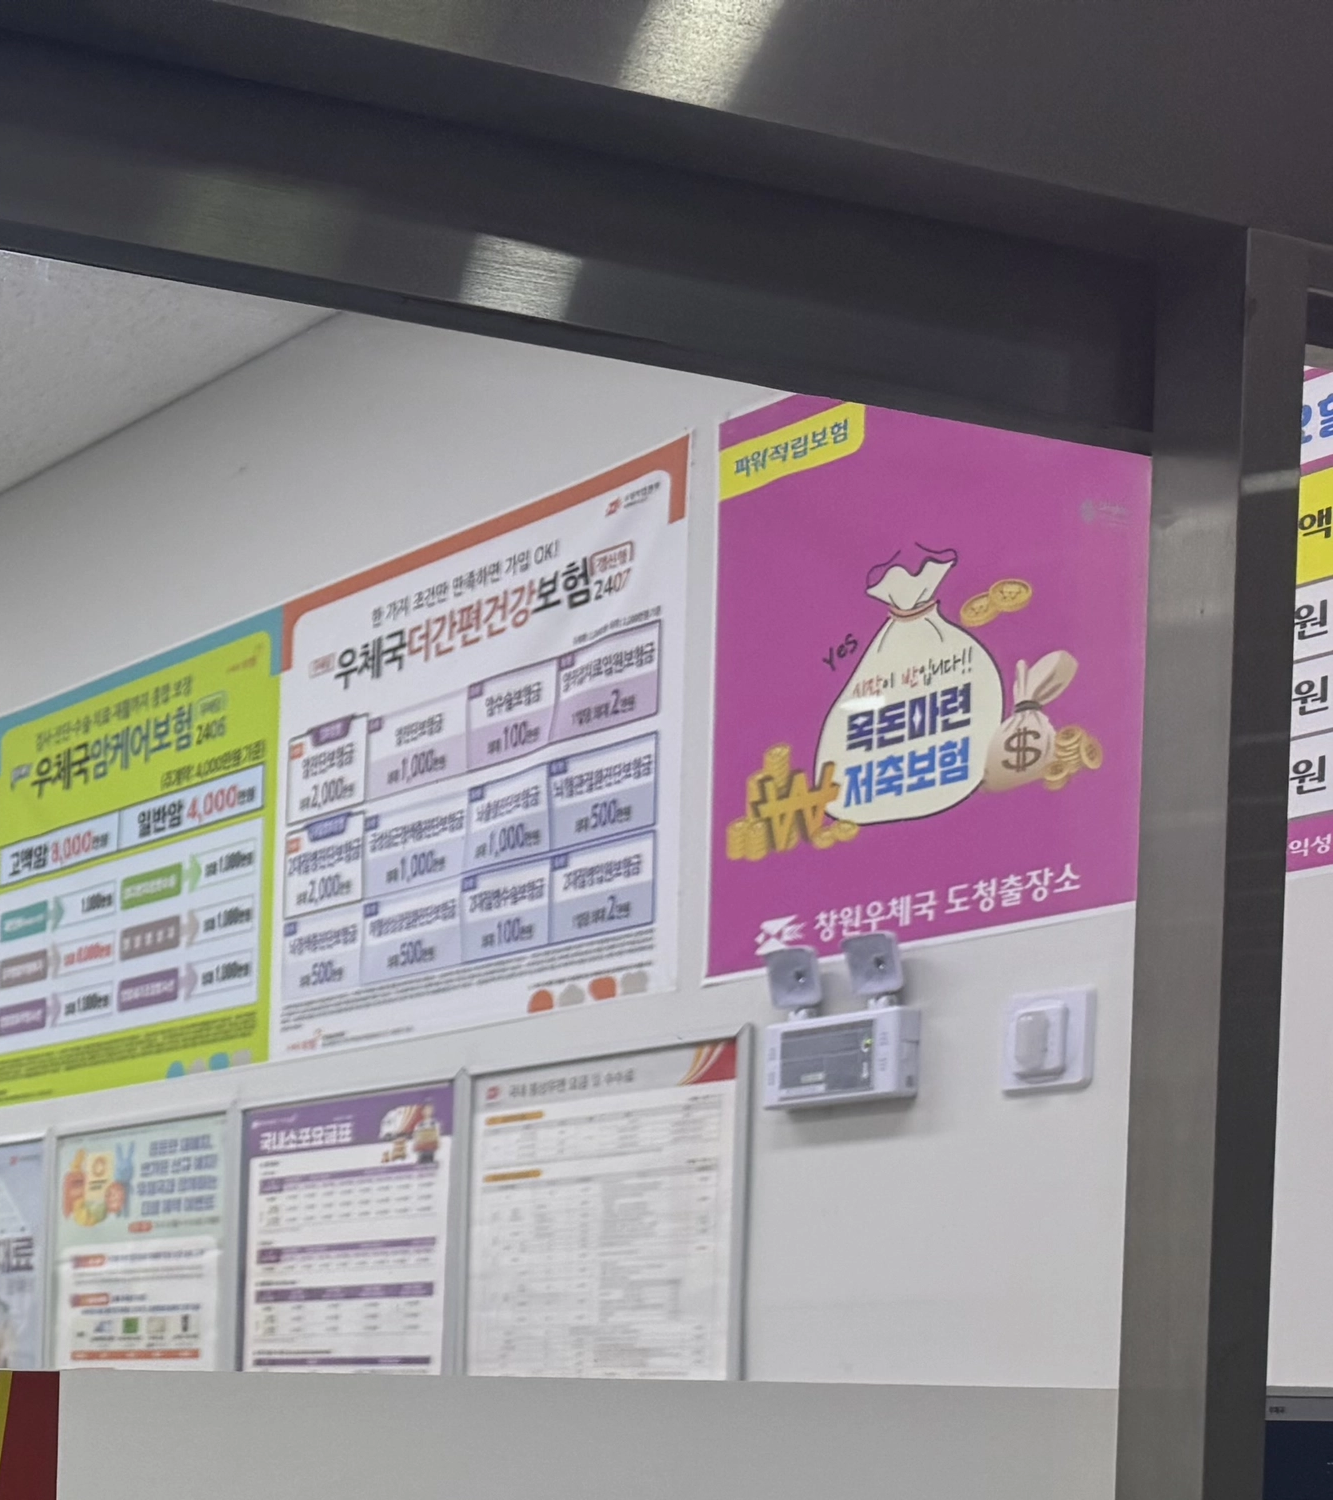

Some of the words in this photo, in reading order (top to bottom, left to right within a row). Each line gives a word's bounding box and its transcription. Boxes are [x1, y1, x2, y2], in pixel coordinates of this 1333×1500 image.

[734, 420, 850, 478] 파워적립보험
[534, 539, 560, 565] OK!
[846, 682, 972, 751] 목돈마련
[1292, 675, 1329, 717] 원
[843, 736, 970, 808] 저축보험
[1290, 754, 1327, 795] 원
[813, 891, 936, 946] 창원우체국
[945, 862, 1082, 916] 도청출장소
